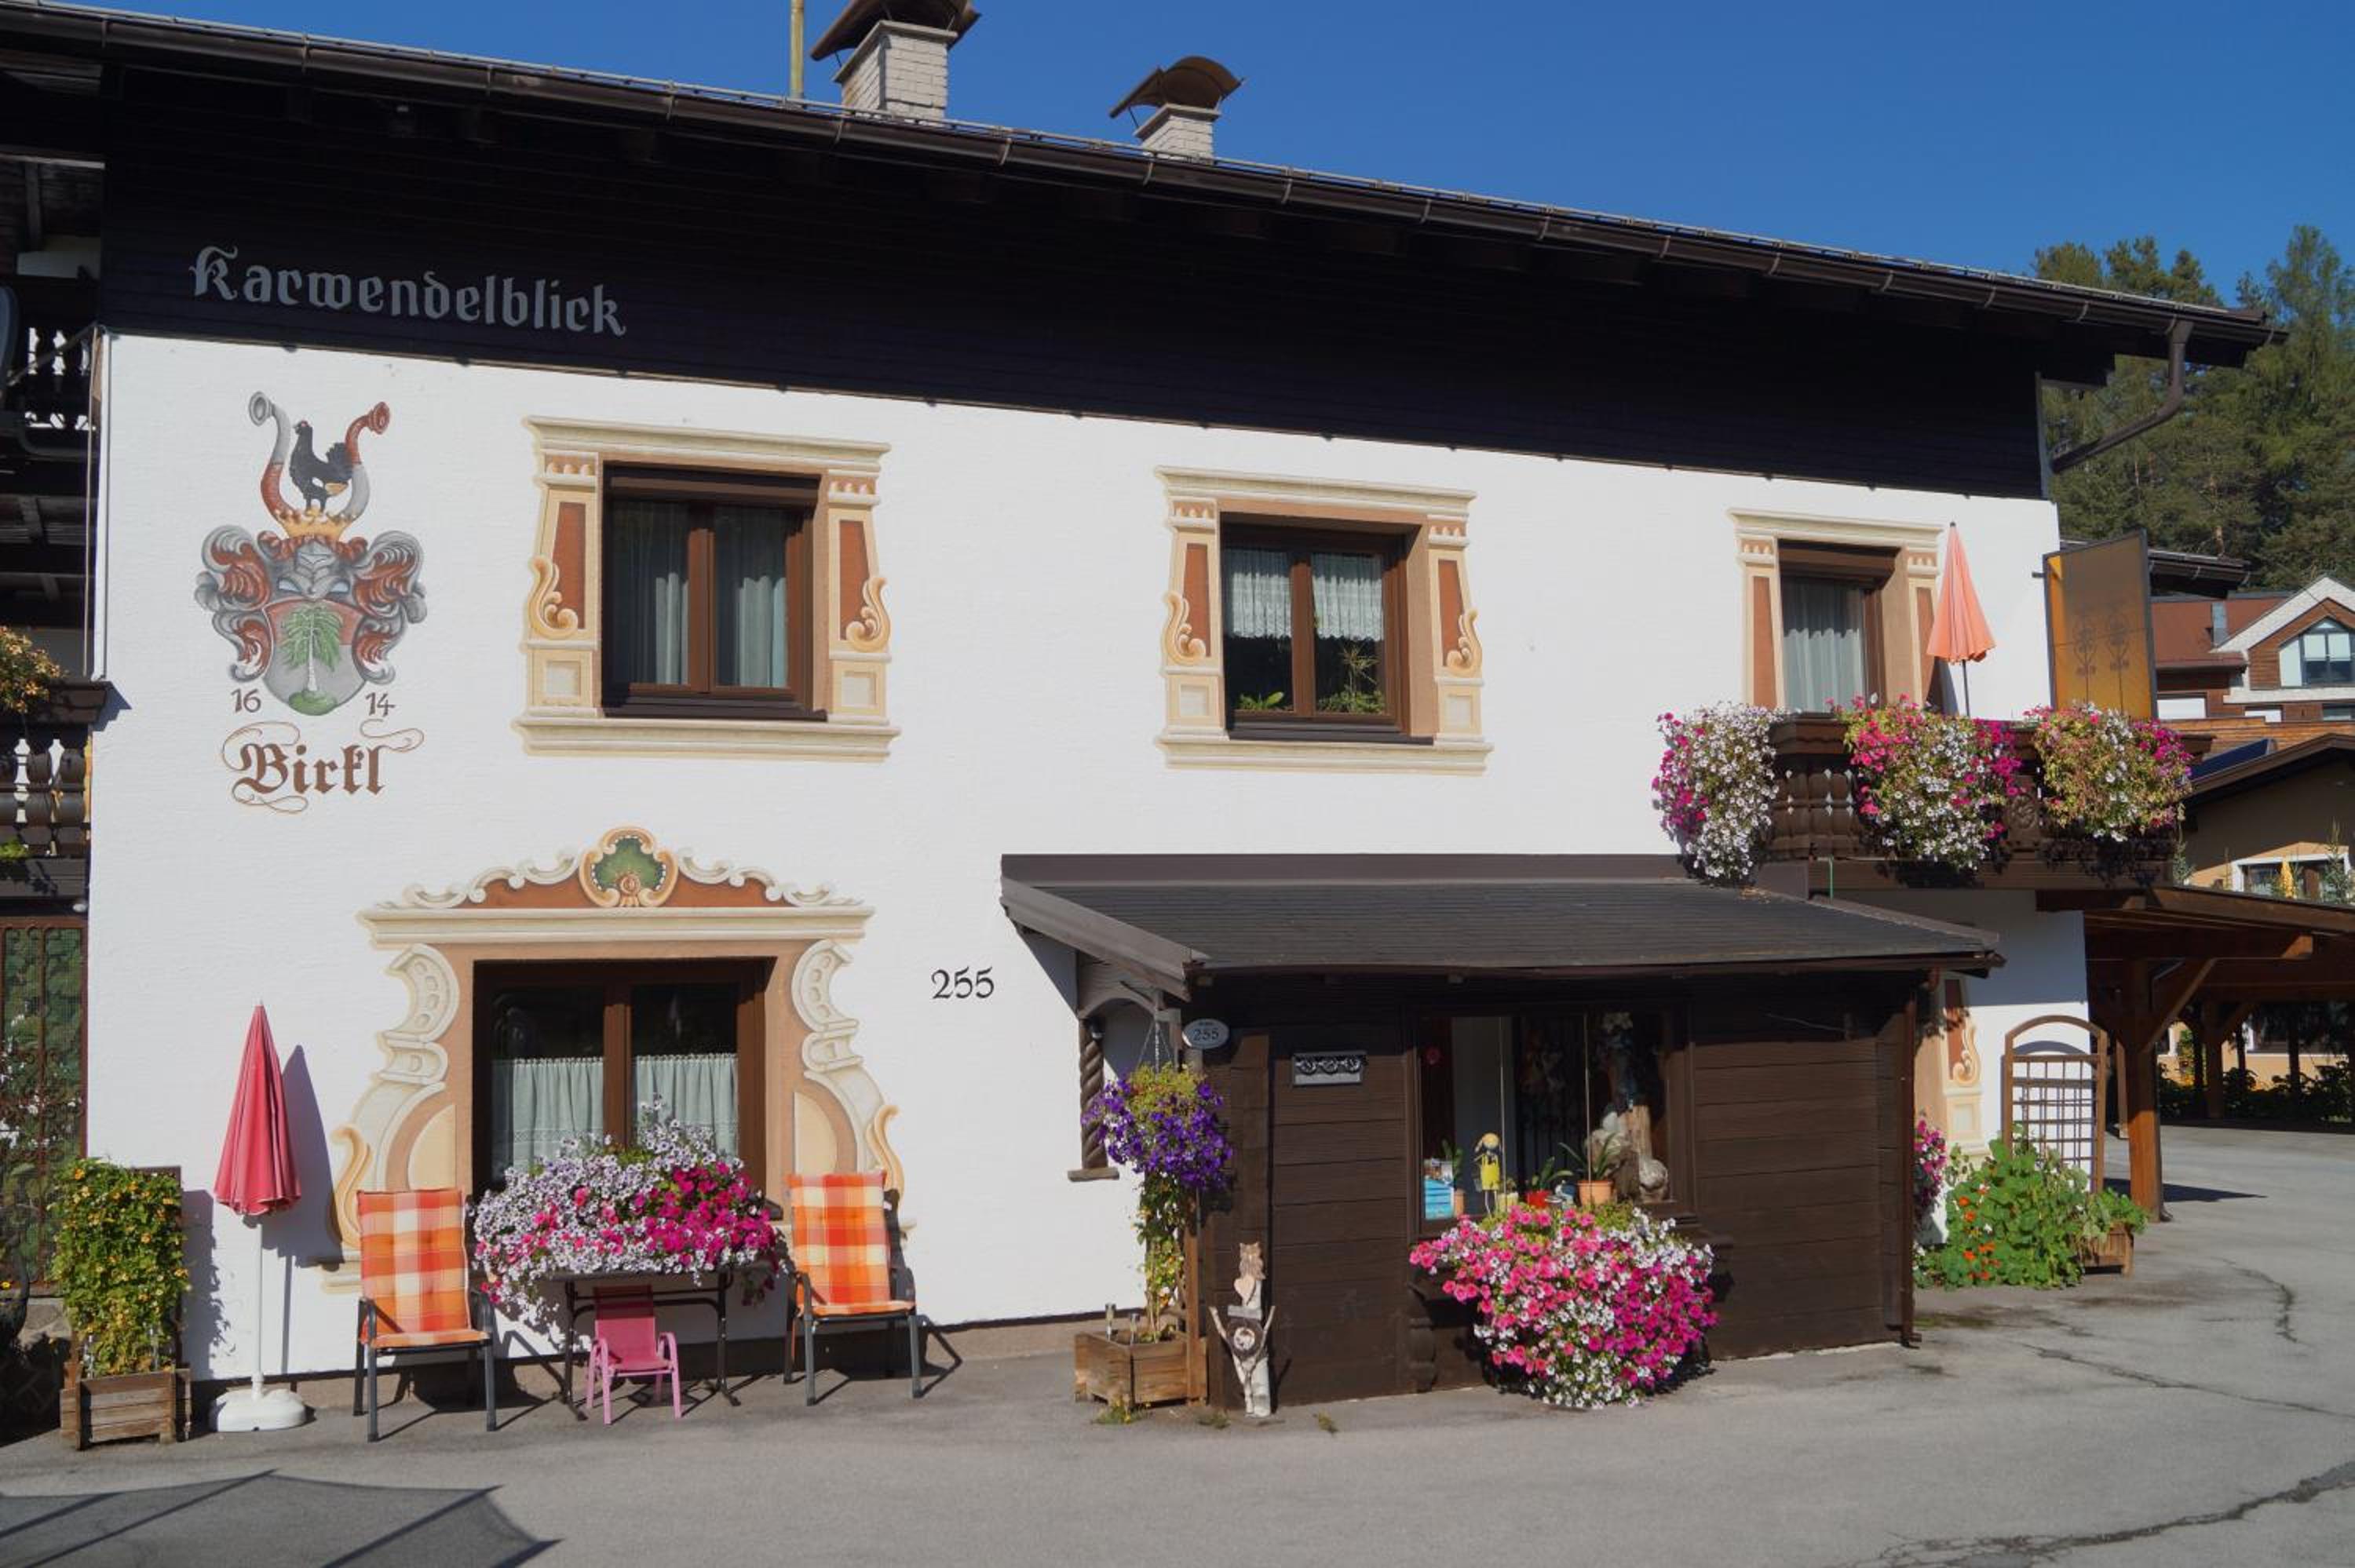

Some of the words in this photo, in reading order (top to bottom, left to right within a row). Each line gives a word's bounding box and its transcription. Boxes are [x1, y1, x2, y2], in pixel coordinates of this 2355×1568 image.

[189, 246, 626, 336] Karwendelblick
[231, 688, 261, 713] 16
[365, 692, 396, 717] 14
[931, 965, 995, 999] 255
[1193, 1027, 1219, 1041] 255
